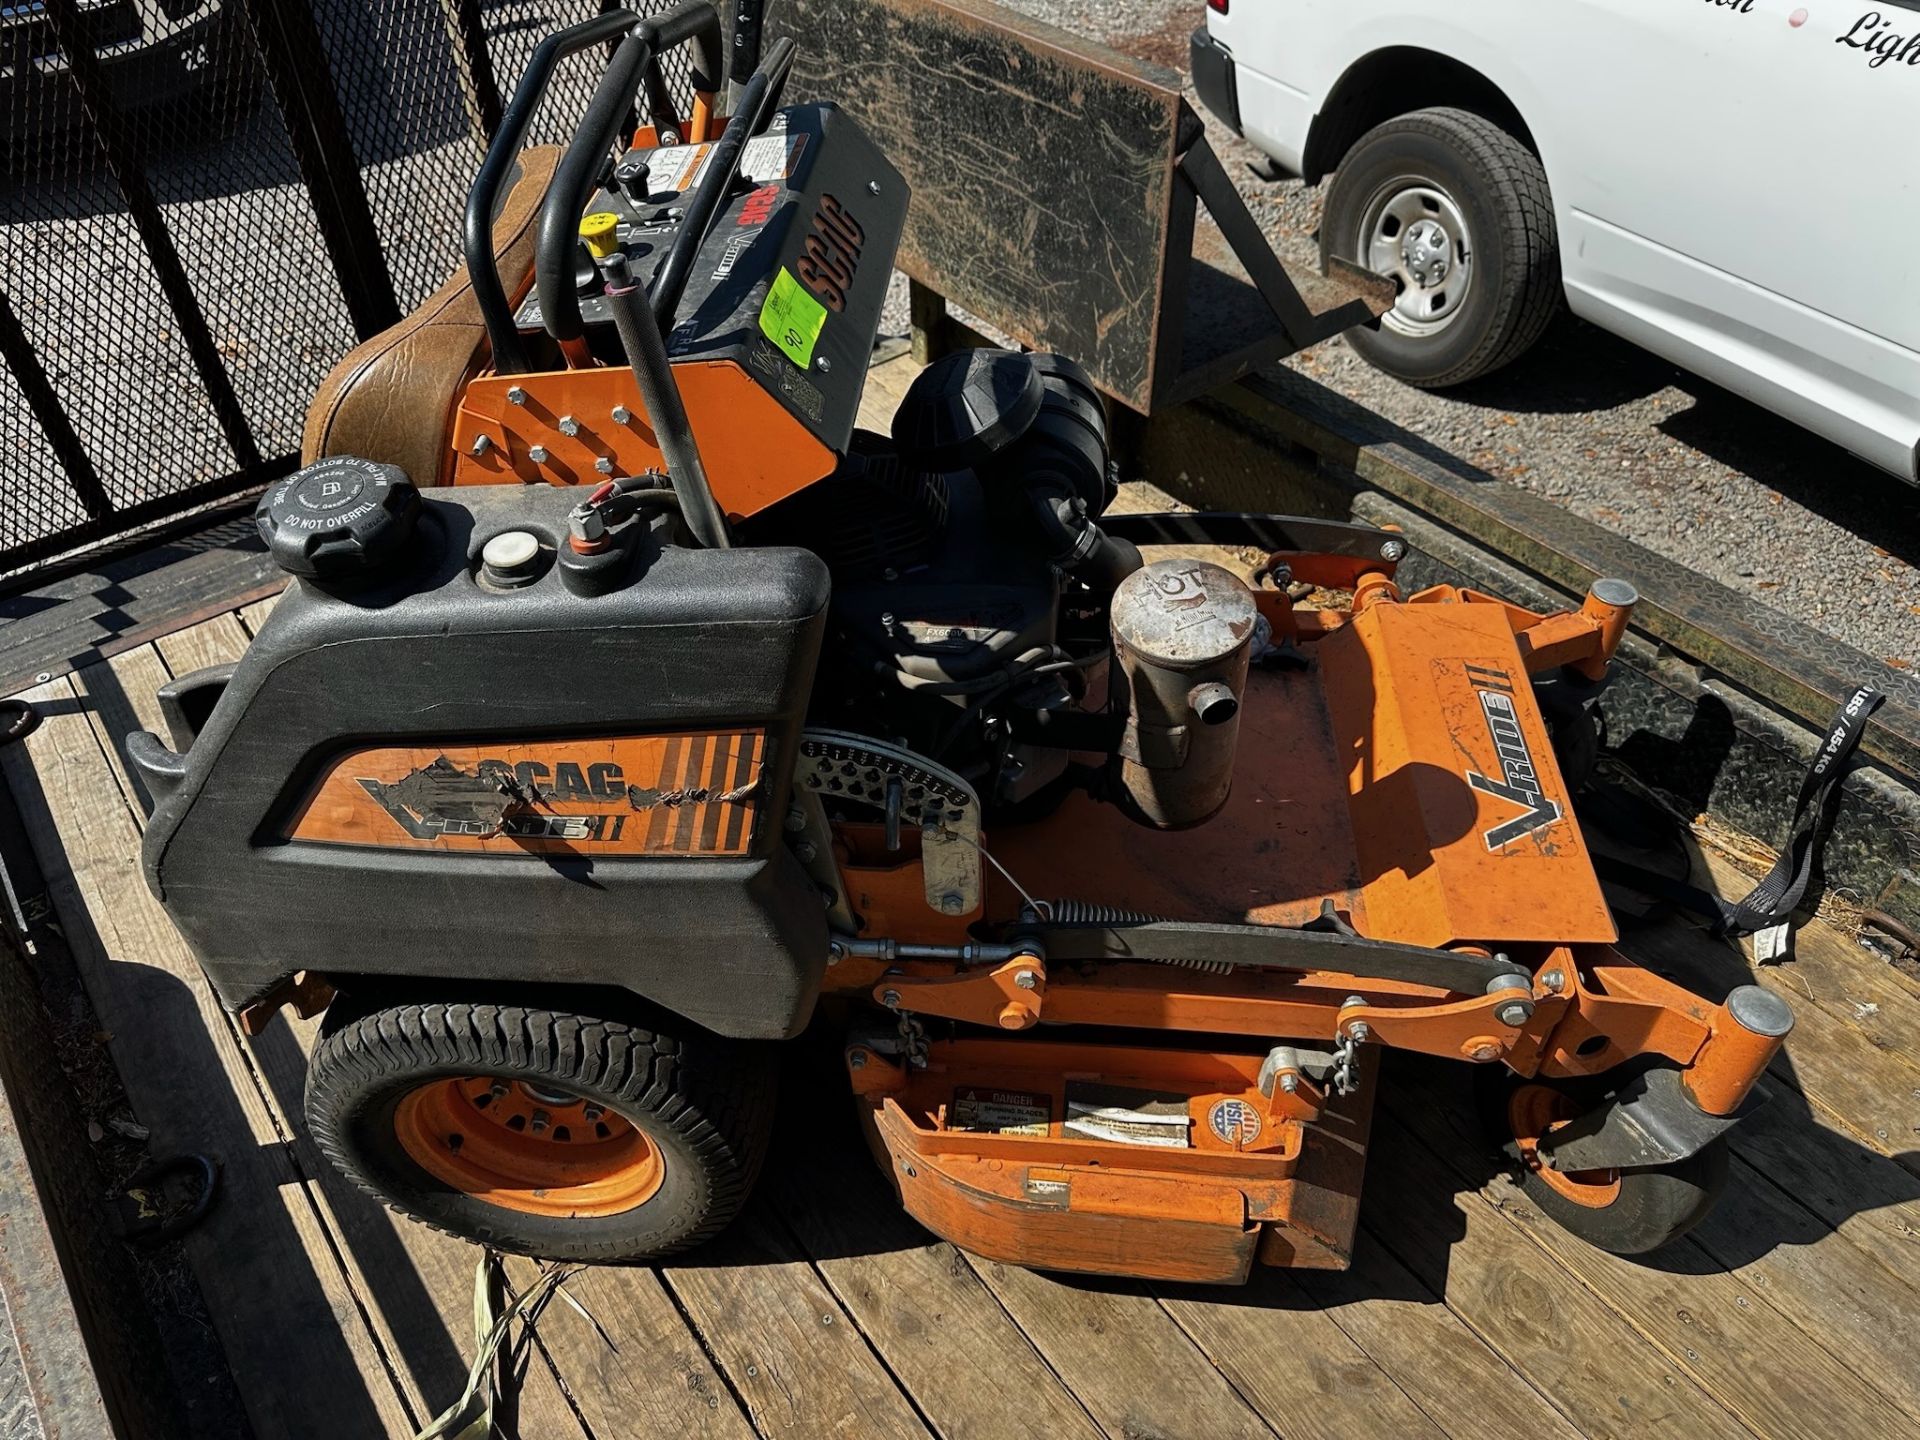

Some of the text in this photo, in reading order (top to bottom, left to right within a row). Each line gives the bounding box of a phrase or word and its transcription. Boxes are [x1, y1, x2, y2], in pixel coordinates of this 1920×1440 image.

[736, 183, 781, 226] SCAG
[796, 193, 866, 313] SCAG
[784, 328, 804, 352] 90
[298, 458, 344, 476] BOTTOM
[345, 458, 360, 466] TO
[284, 501, 377, 530] DO NOT OVERFILL
[1845, 690, 1869, 717] LBS
[1826, 726, 1846, 753] 454
[1814, 754, 1833, 774] KG
[992, 1092, 1033, 1106] DANGER
[1226, 1102, 1243, 1126] USA
